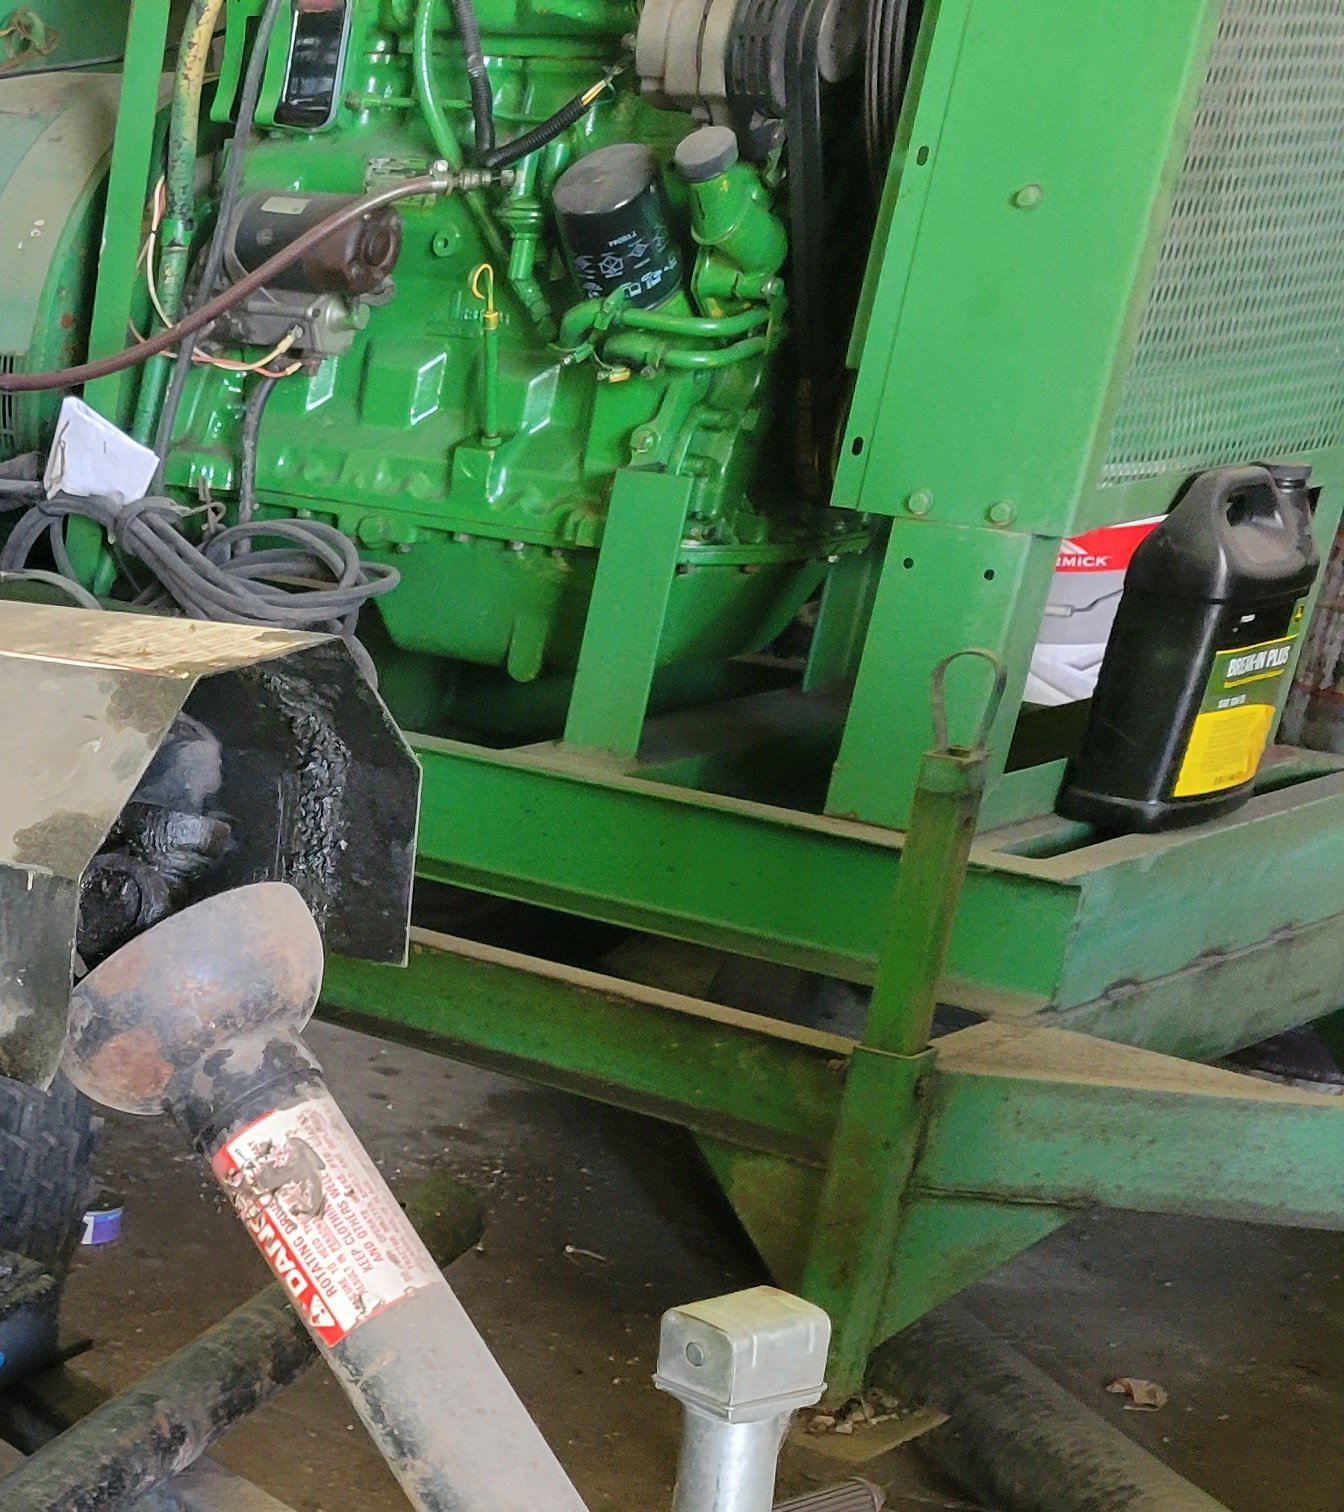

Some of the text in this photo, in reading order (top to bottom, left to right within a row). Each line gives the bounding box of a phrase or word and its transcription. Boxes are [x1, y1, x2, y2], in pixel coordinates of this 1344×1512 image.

[233, 1188, 310, 1296] DANG
[310, 1237, 329, 1260] HEED
[318, 1172, 384, 1264] AND OTHERS WELL
[318, 1198, 374, 1274] KEEP CLOTHIN
[291, 1234, 338, 1298] ROTATING
[334, 1253, 347, 1265] IN
